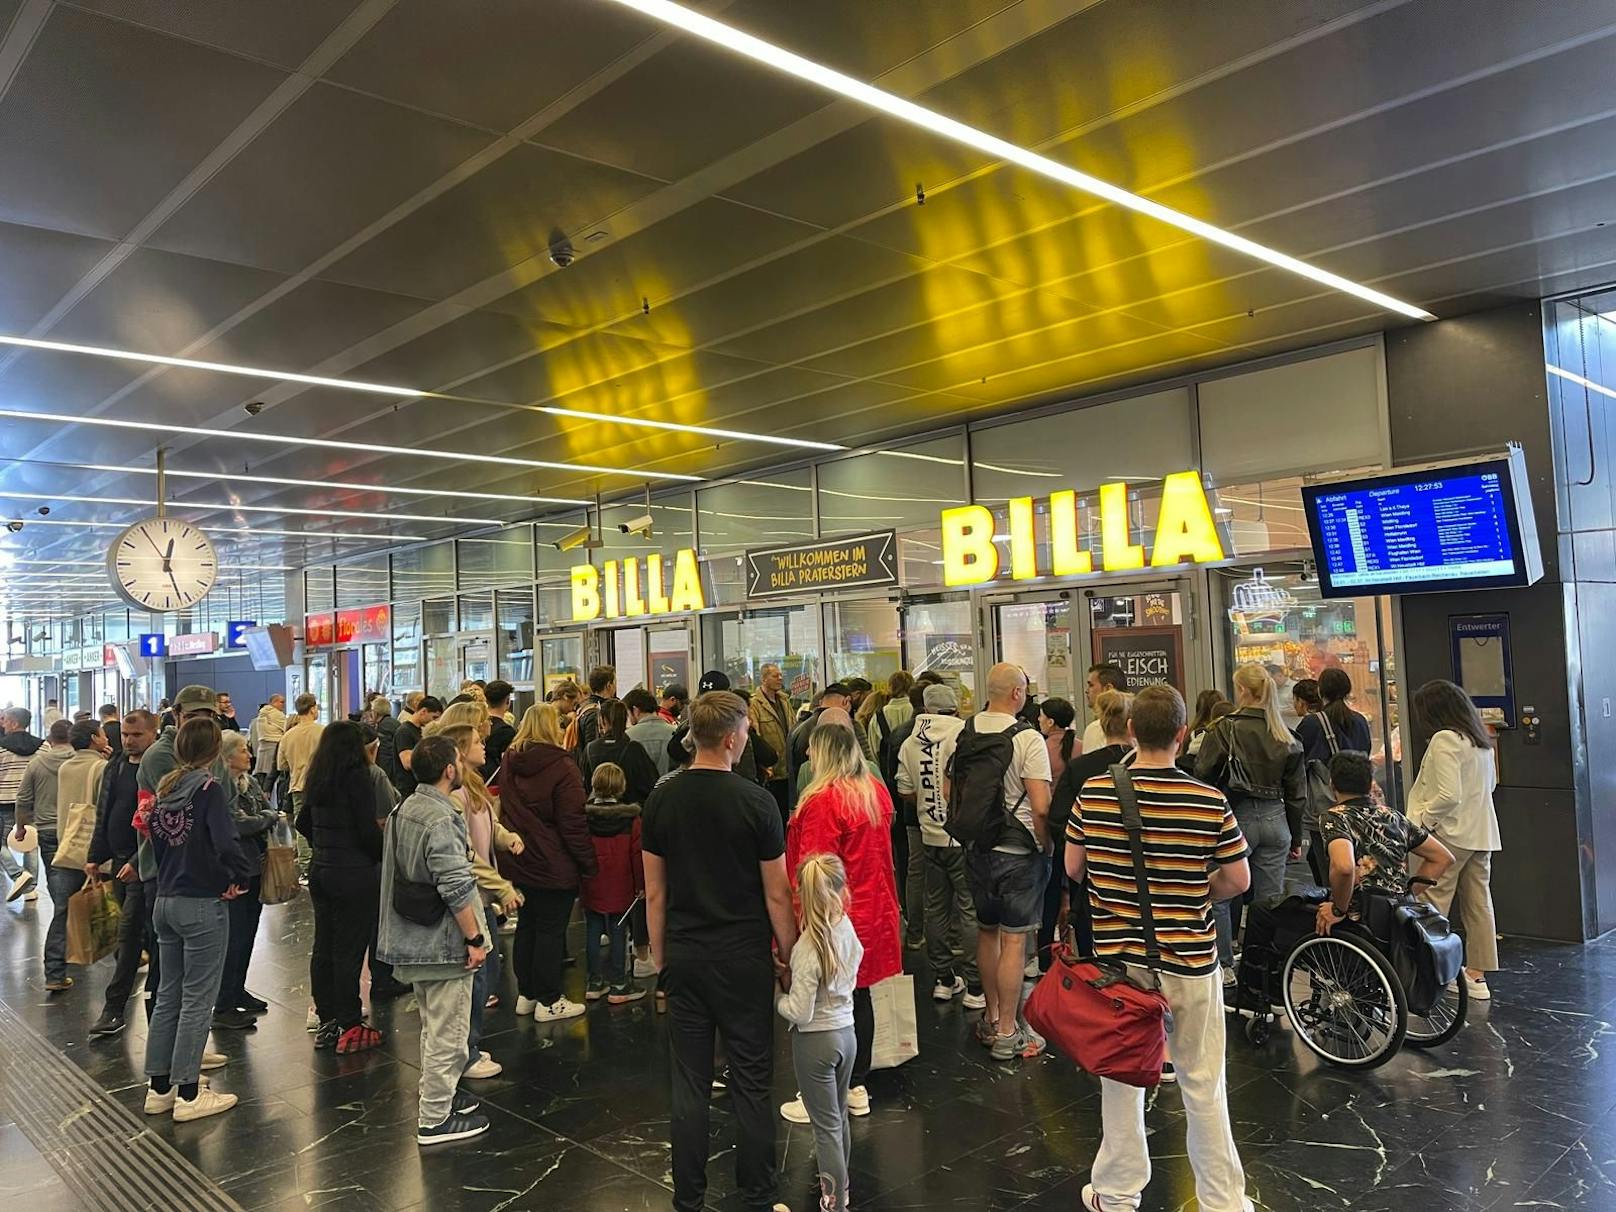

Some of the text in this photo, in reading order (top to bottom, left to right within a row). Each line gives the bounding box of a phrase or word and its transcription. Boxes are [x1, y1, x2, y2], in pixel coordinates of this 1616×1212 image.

[1368, 488, 1399, 498] Departure
[1414, 482, 1443, 491] 12:27:53
[1325, 494, 1346, 502] Abfahrt
[941, 470, 1224, 587] BILLA
[777, 545, 865, 570] WILLKOMMEN IM
[571, 548, 705, 621] BILLA
[770, 563, 867, 588] BILLA PRATERSTERN
[235, 625, 247, 644] 2
[1456, 623, 1501, 632] Entwerter
[147, 636, 158, 654] 1
[920, 741, 938, 822] ALPHA
